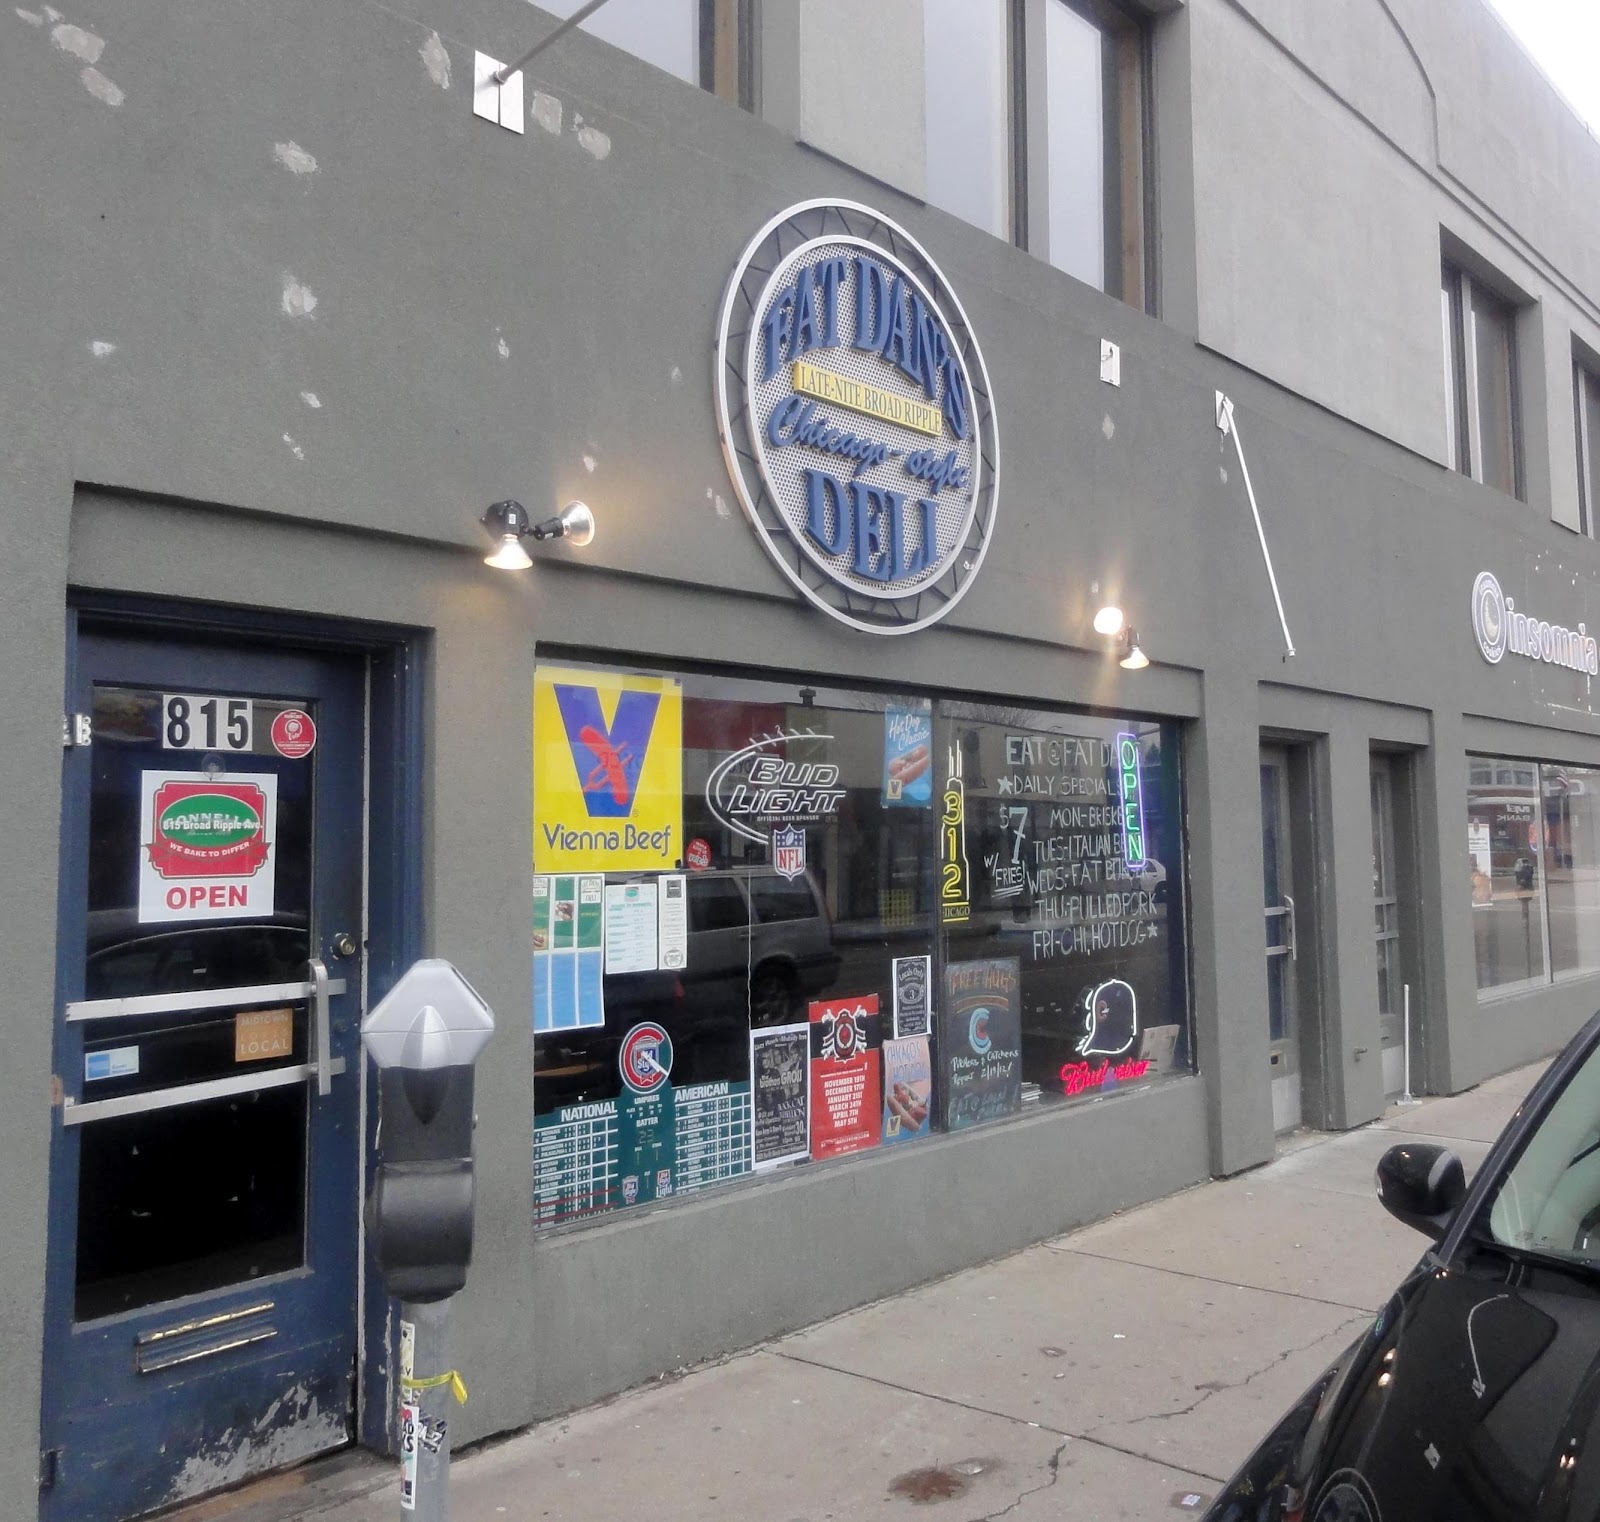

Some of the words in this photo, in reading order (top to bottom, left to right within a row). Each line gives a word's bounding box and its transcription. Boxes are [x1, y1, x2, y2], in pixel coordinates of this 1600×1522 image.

[761, 256, 846, 383] FAT
[851, 255, 969, 441] DAN'S
[800, 366, 862, 408] LATE-NITE
[863, 390, 903, 421] BROAD
[903, 401, 942, 434] RIPPLE
[804, 469, 941, 583] DELI
[1505, 597, 1598, 676] insomnia
[166, 696, 250, 749] 815
[889, 714, 906, 738] Hot
[905, 713, 921, 732] Dog
[898, 727, 930, 751] Classic
[1006, 736, 1046, 765] EAT
[1063, 739, 1097, 767] FAT
[748, 757, 840, 787] BUD
[1013, 775, 1055, 796] DAILY
[1060, 775, 1123, 797] SPECIALS
[726, 785, 847, 813] LIGHT
[1120, 739, 1144, 862] OPEN
[182, 820, 211, 830] Broad
[213, 820, 242, 832] Ripple
[169, 841, 182, 852] WE
[184, 847, 207, 858] BAKE
[222, 841, 250, 856] DIFFER
[542, 822, 619, 852] Vienna
[624, 824, 673, 857] Beef
[777, 849, 802, 870] NFL
[166, 885, 248, 910] OPEN
[941, 906, 971, 918] HICAGO
[1092, 922, 1118, 950] HOT
[950, 969, 983, 995] FREE
[984, 968, 1016, 994] HUGS
[240, 1039, 288, 1054] LOCAL
[674, 1082, 729, 1102] AMERICAN
[824, 1077, 853, 1088] NOVEMBER
[825, 1085, 853, 1097] DECEMBER
[827, 1093, 852, 1104] JANUARY
[829, 1101, 849, 1112] MARCH
[561, 1101, 618, 1122] NATIONAL
[832, 1109, 849, 1120] APRIL
[834, 1119, 847, 1129] MAY
